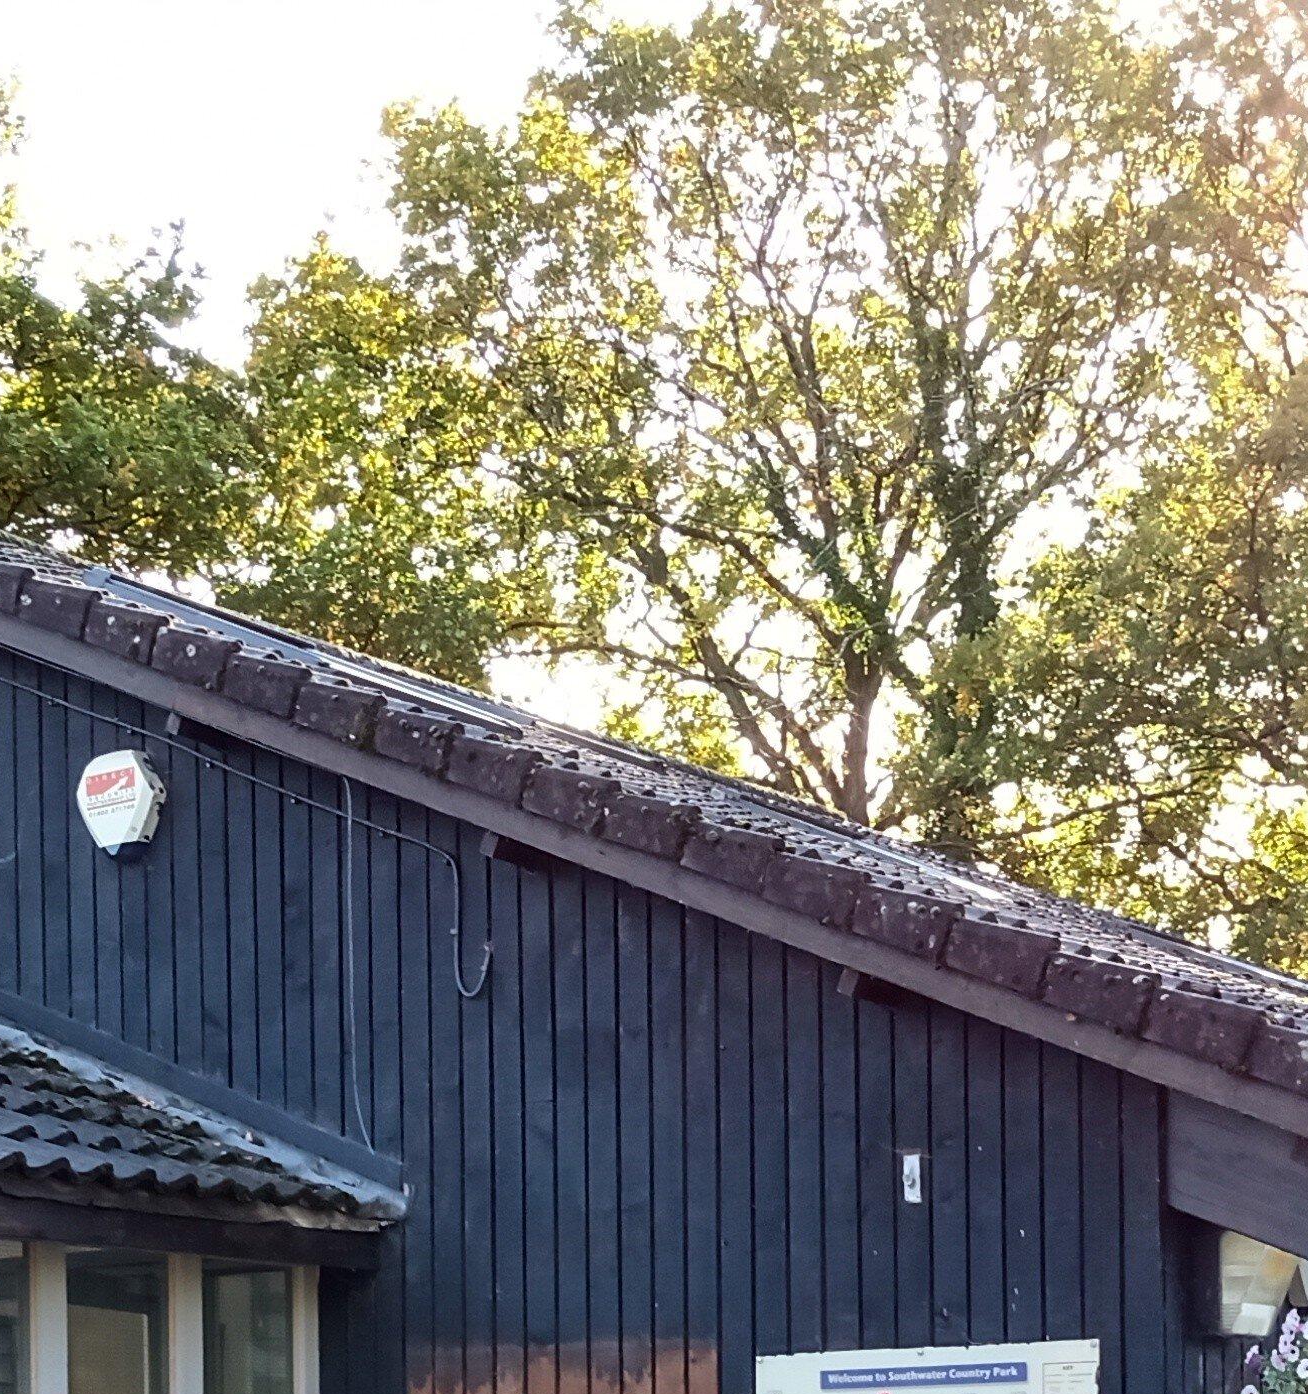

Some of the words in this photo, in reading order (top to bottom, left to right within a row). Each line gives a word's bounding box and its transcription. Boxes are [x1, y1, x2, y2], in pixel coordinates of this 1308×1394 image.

[828, 1373, 873, 1384] Welcome
[876, 1373, 887, 1382] to
[888, 1370, 947, 1381] Southwater
[949, 1368, 990, 1380] Country
[993, 1366, 1018, 1376] Park
